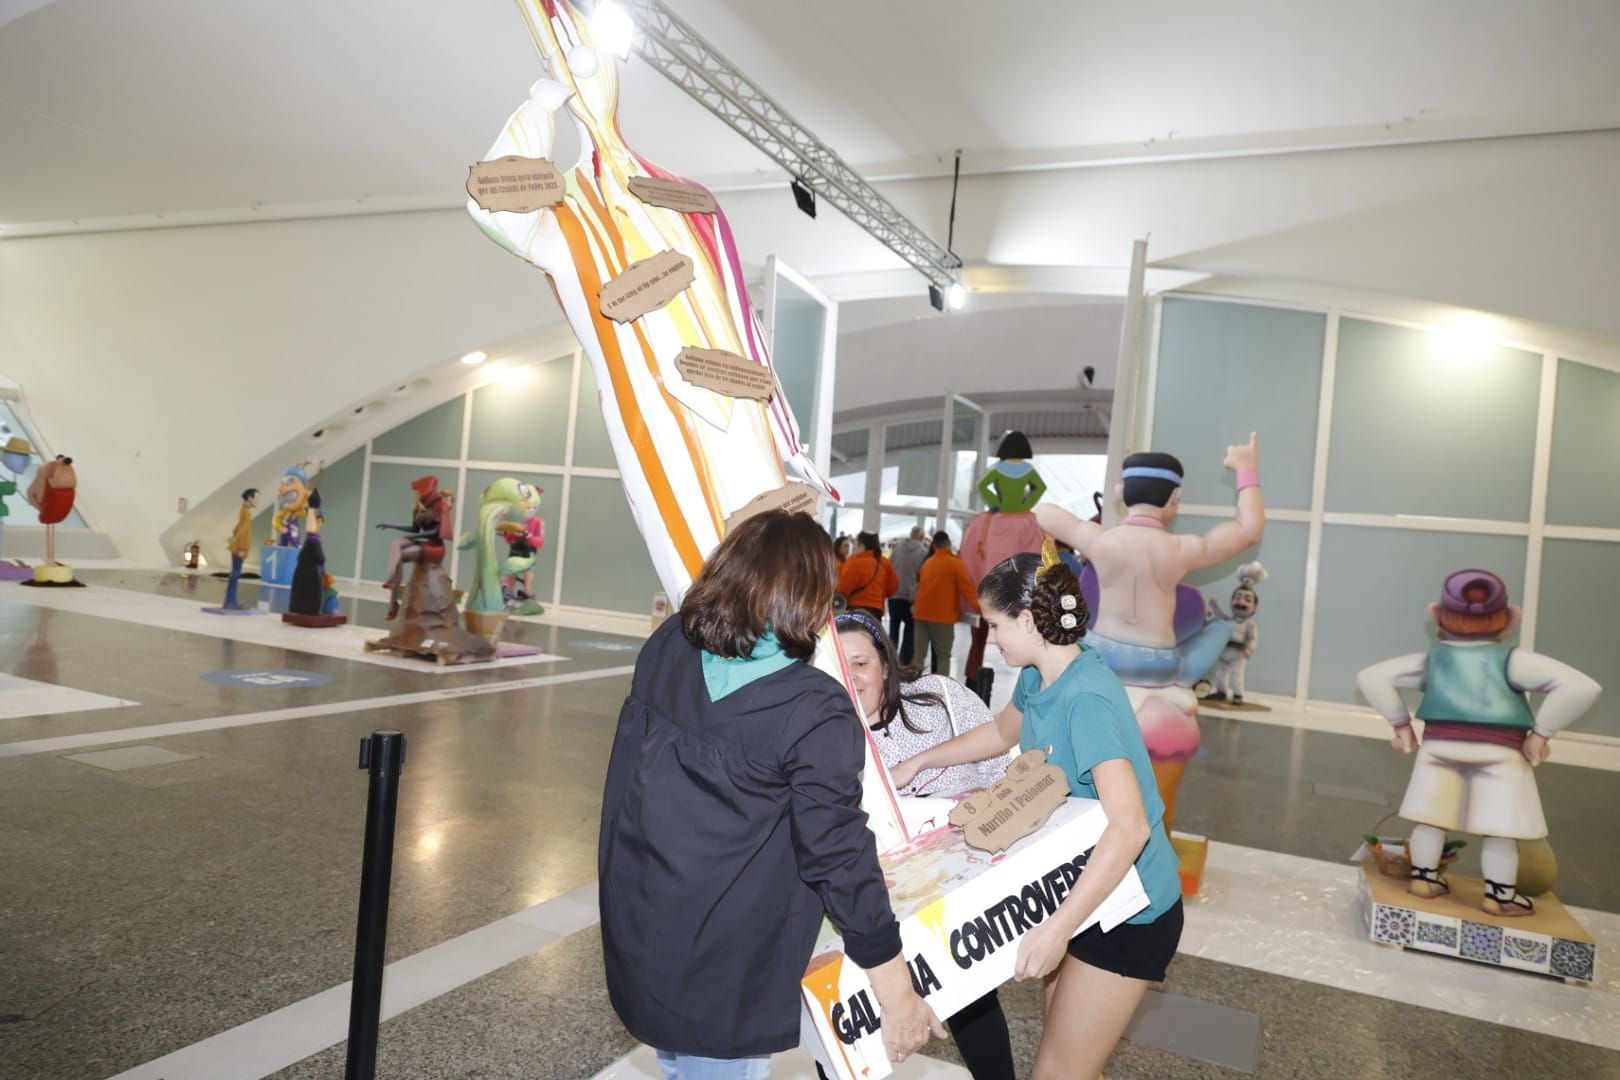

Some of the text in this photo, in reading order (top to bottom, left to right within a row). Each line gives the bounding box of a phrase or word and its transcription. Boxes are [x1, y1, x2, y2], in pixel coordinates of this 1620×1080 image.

[266, 550, 278, 580] 1
[963, 801, 976, 815] 8
[977, 807, 1014, 837] Murillo
[1015, 774, 1056, 808] Palomar
